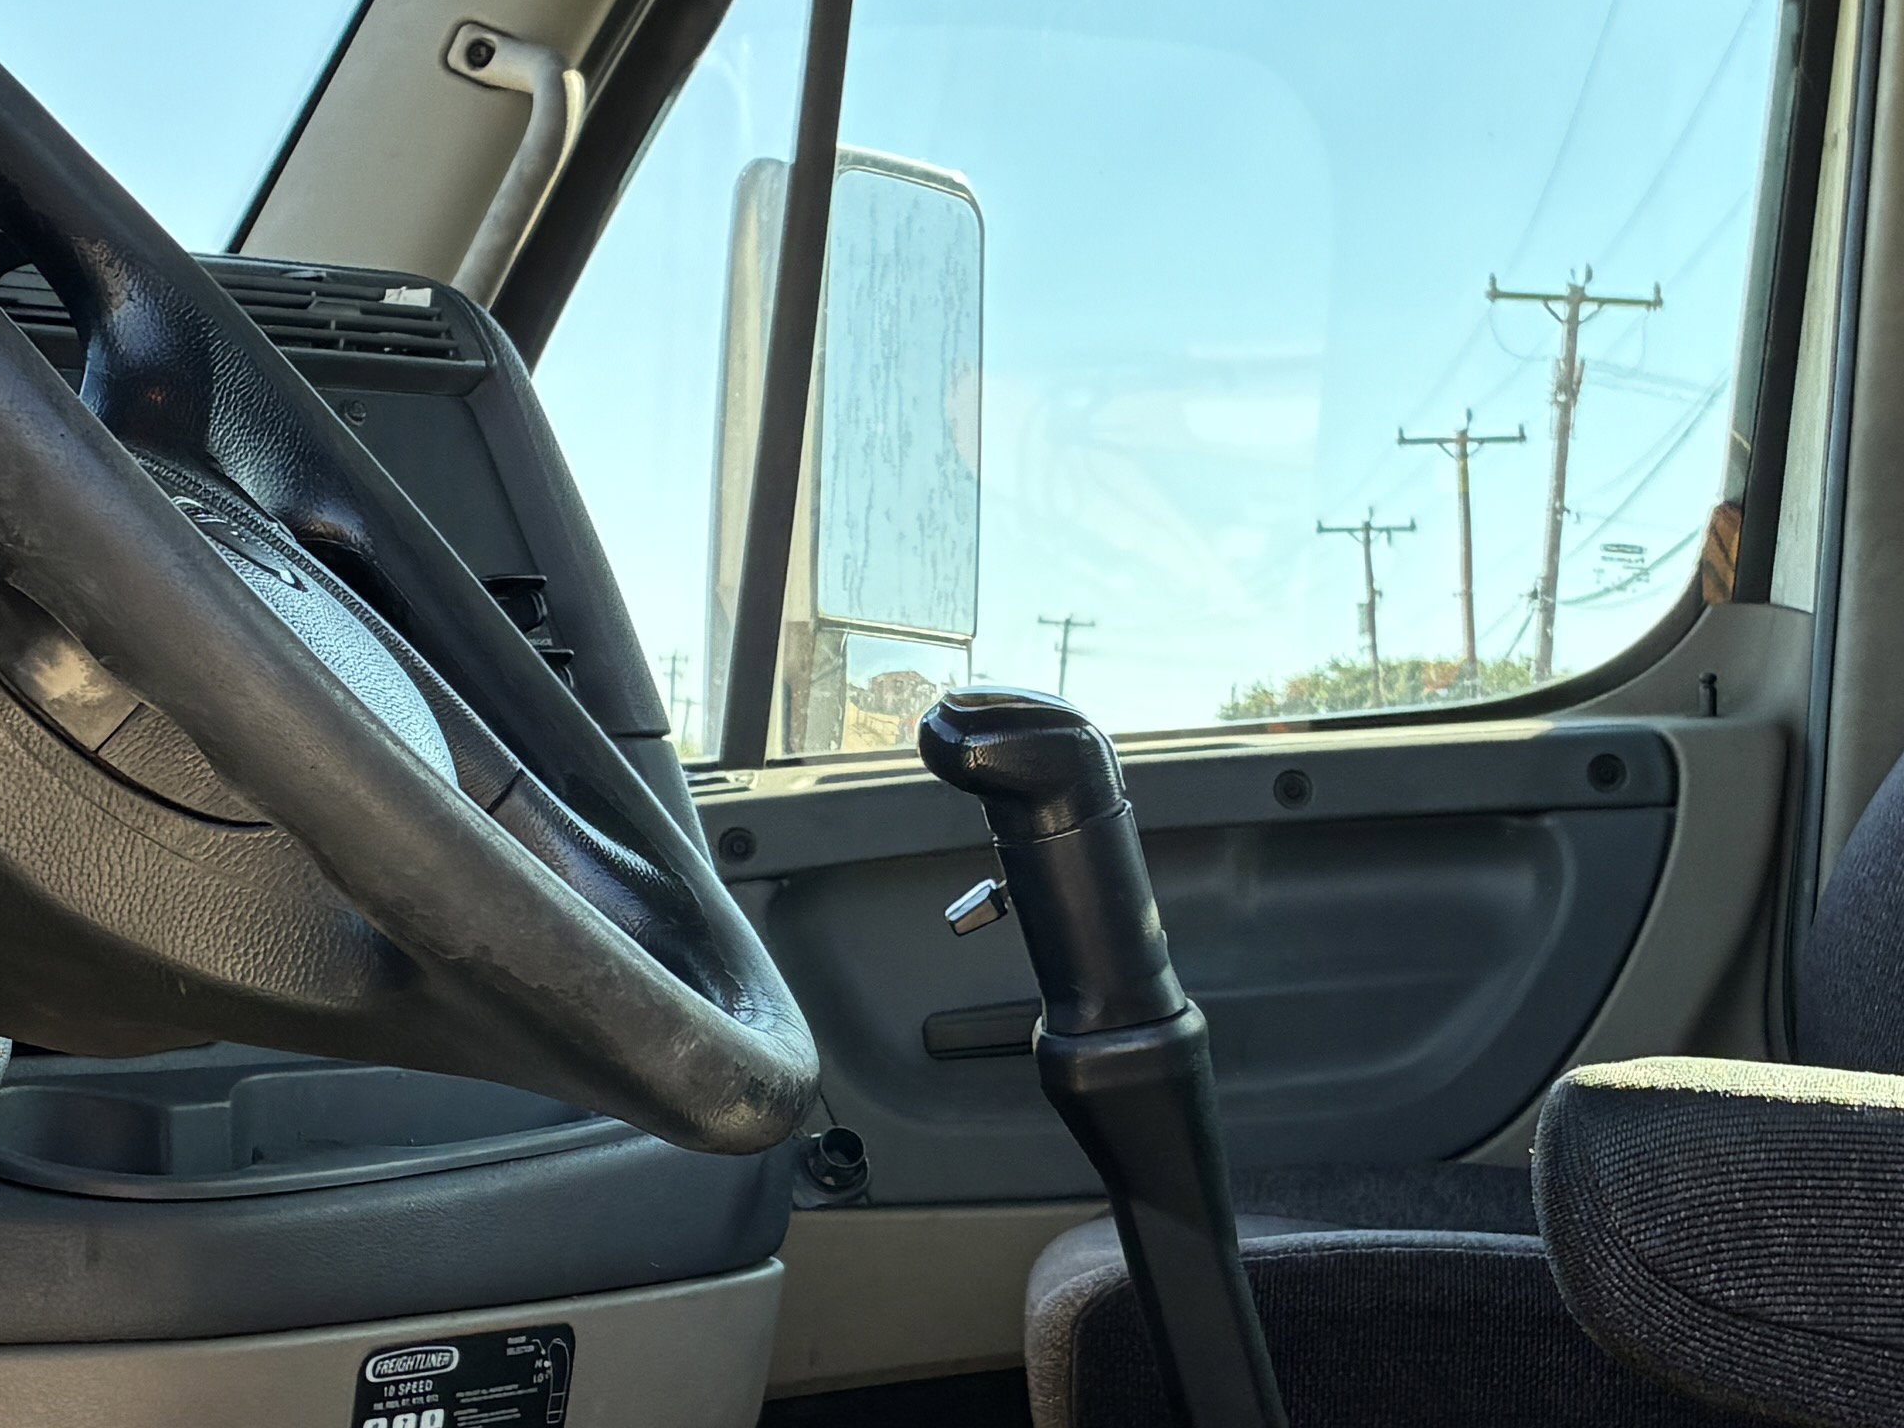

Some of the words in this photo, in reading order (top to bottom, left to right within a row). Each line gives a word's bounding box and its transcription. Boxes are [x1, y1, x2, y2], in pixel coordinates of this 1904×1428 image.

[375, 1352, 451, 1376] FREIGHTLINER
[384, 1384, 396, 1397] 10
[398, 1379, 434, 1396] SPEED
